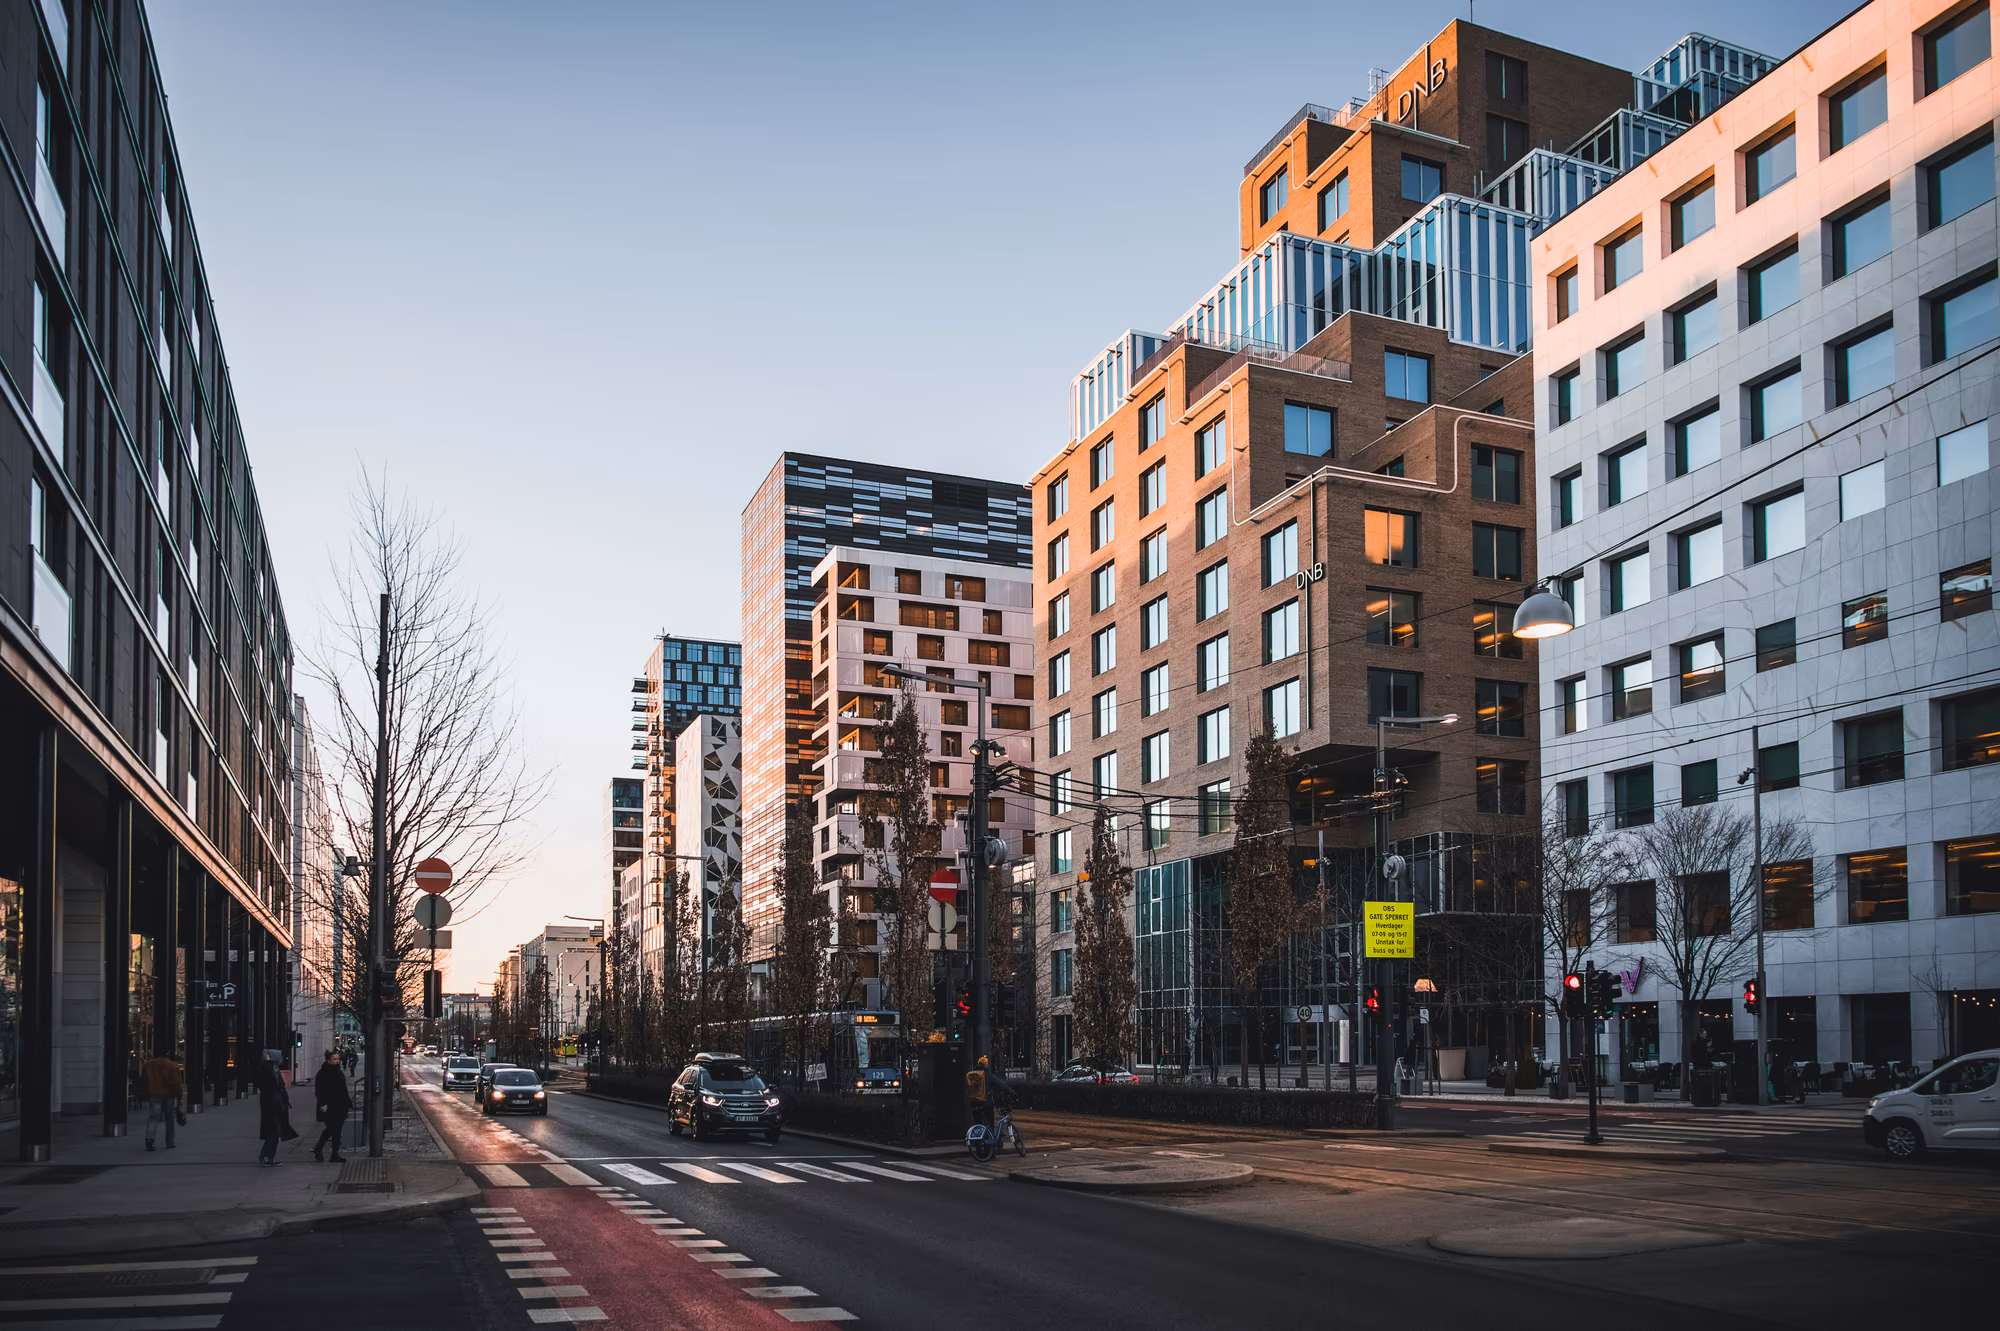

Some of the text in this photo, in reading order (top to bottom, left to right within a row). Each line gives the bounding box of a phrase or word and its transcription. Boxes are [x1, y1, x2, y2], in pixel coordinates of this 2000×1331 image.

[1398, 47, 1446, 124] DNB
[1296, 562, 1324, 590] DNB
[1385, 913, 1409, 921] SPERRET
[1375, 922, 1404, 930] Hverdager
[224, 987, 235, 999] P
[1299, 1008, 1310, 1018] 40
